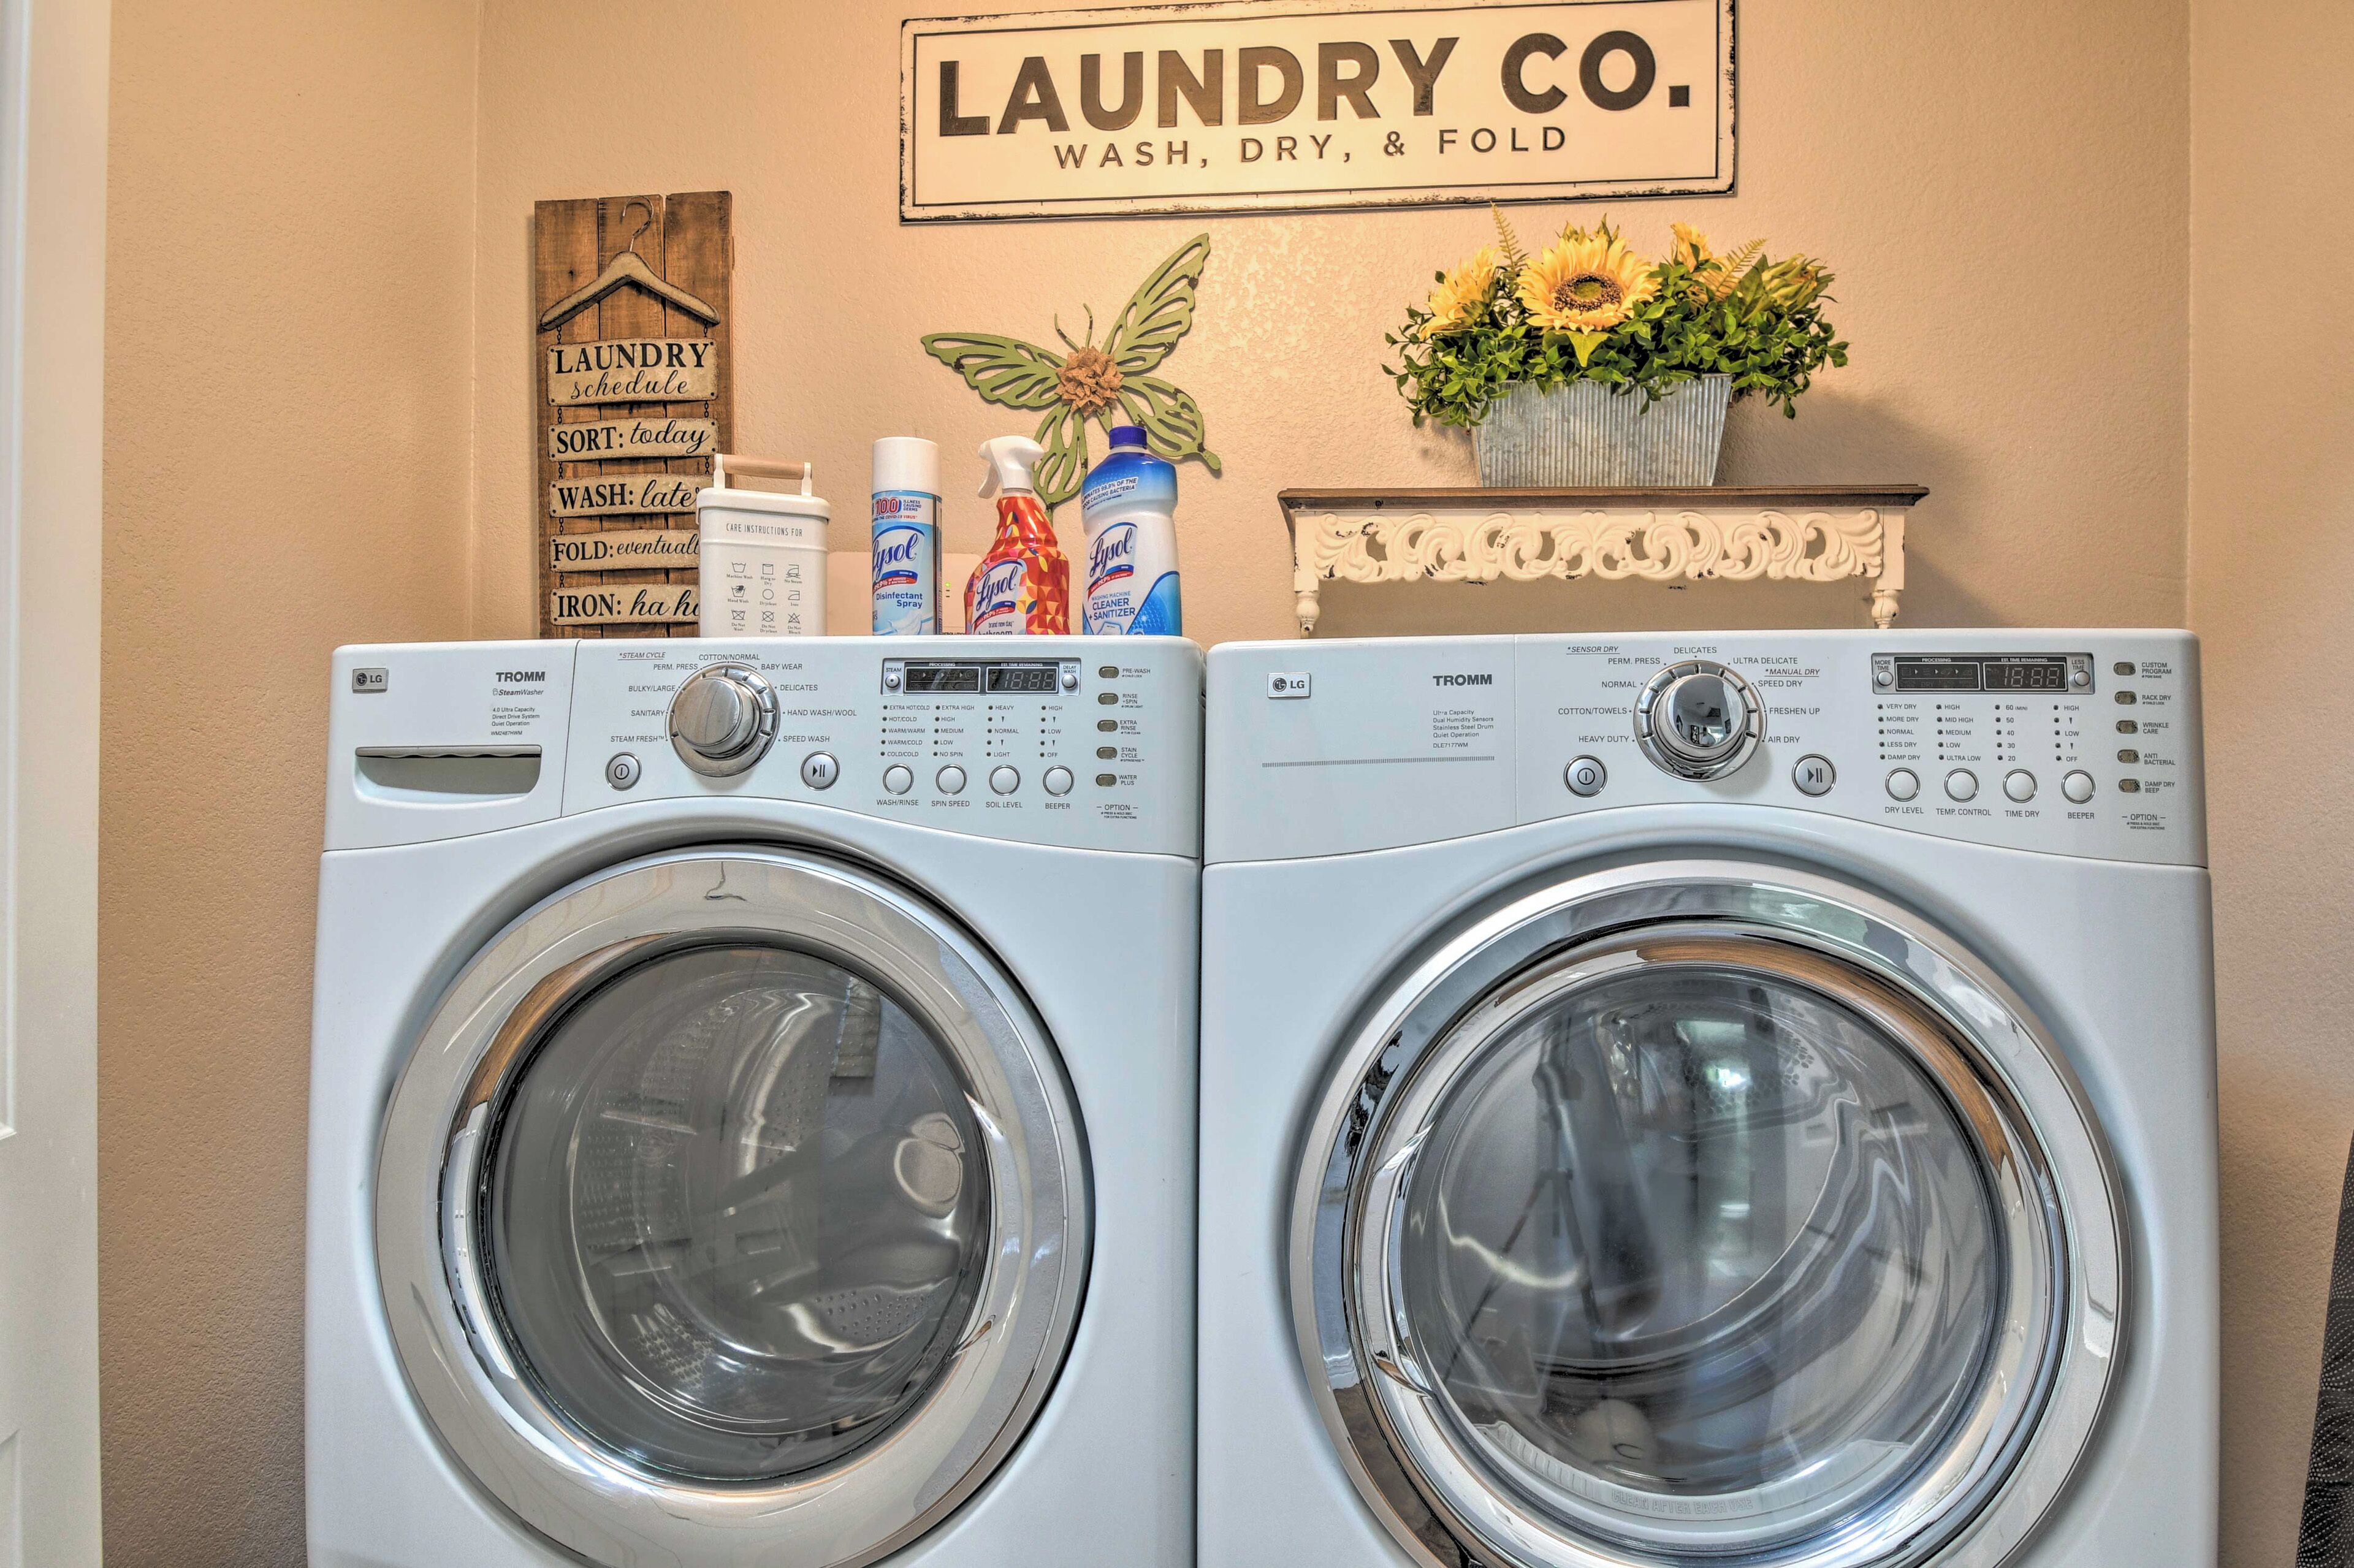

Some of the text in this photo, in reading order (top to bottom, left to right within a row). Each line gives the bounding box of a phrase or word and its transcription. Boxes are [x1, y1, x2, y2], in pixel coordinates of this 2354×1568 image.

[938, 29, 1689, 137] LAUNDRY CO.
[1053, 126, 1566, 170] WASH, DRY, & FOLD
[555, 343, 709, 374] LAUNDRY
[571, 370, 688, 399] schedule
[557, 420, 710, 454] SORT: today
[558, 484, 633, 509] WASH:
[1091, 485, 1135, 502] CAUSING BACTERIA
[875, 497, 900, 515] 100
[726, 523, 741, 532] CARE
[745, 525, 788, 536] INSTRUCTIONS
[554, 541, 613, 561] FOLD:
[1089, 527, 1132, 577] Lysol
[877, 592, 923, 600] Disinfectant
[976, 566, 1018, 611] Lysol
[558, 594, 621, 618] IRON:
[630, 590, 670, 616] ha
[897, 599, 922, 609] Spray
[1093, 598, 1129, 611] CLEANER
[1094, 607, 1135, 620] SANITIZER
[496, 671, 545, 682] TROMM
[1290, 680, 1305, 689] LG
[1433, 674, 1492, 686] TROMM
[1612, 1489, 1753, 1515] CLEAN AFTER EACH USE
